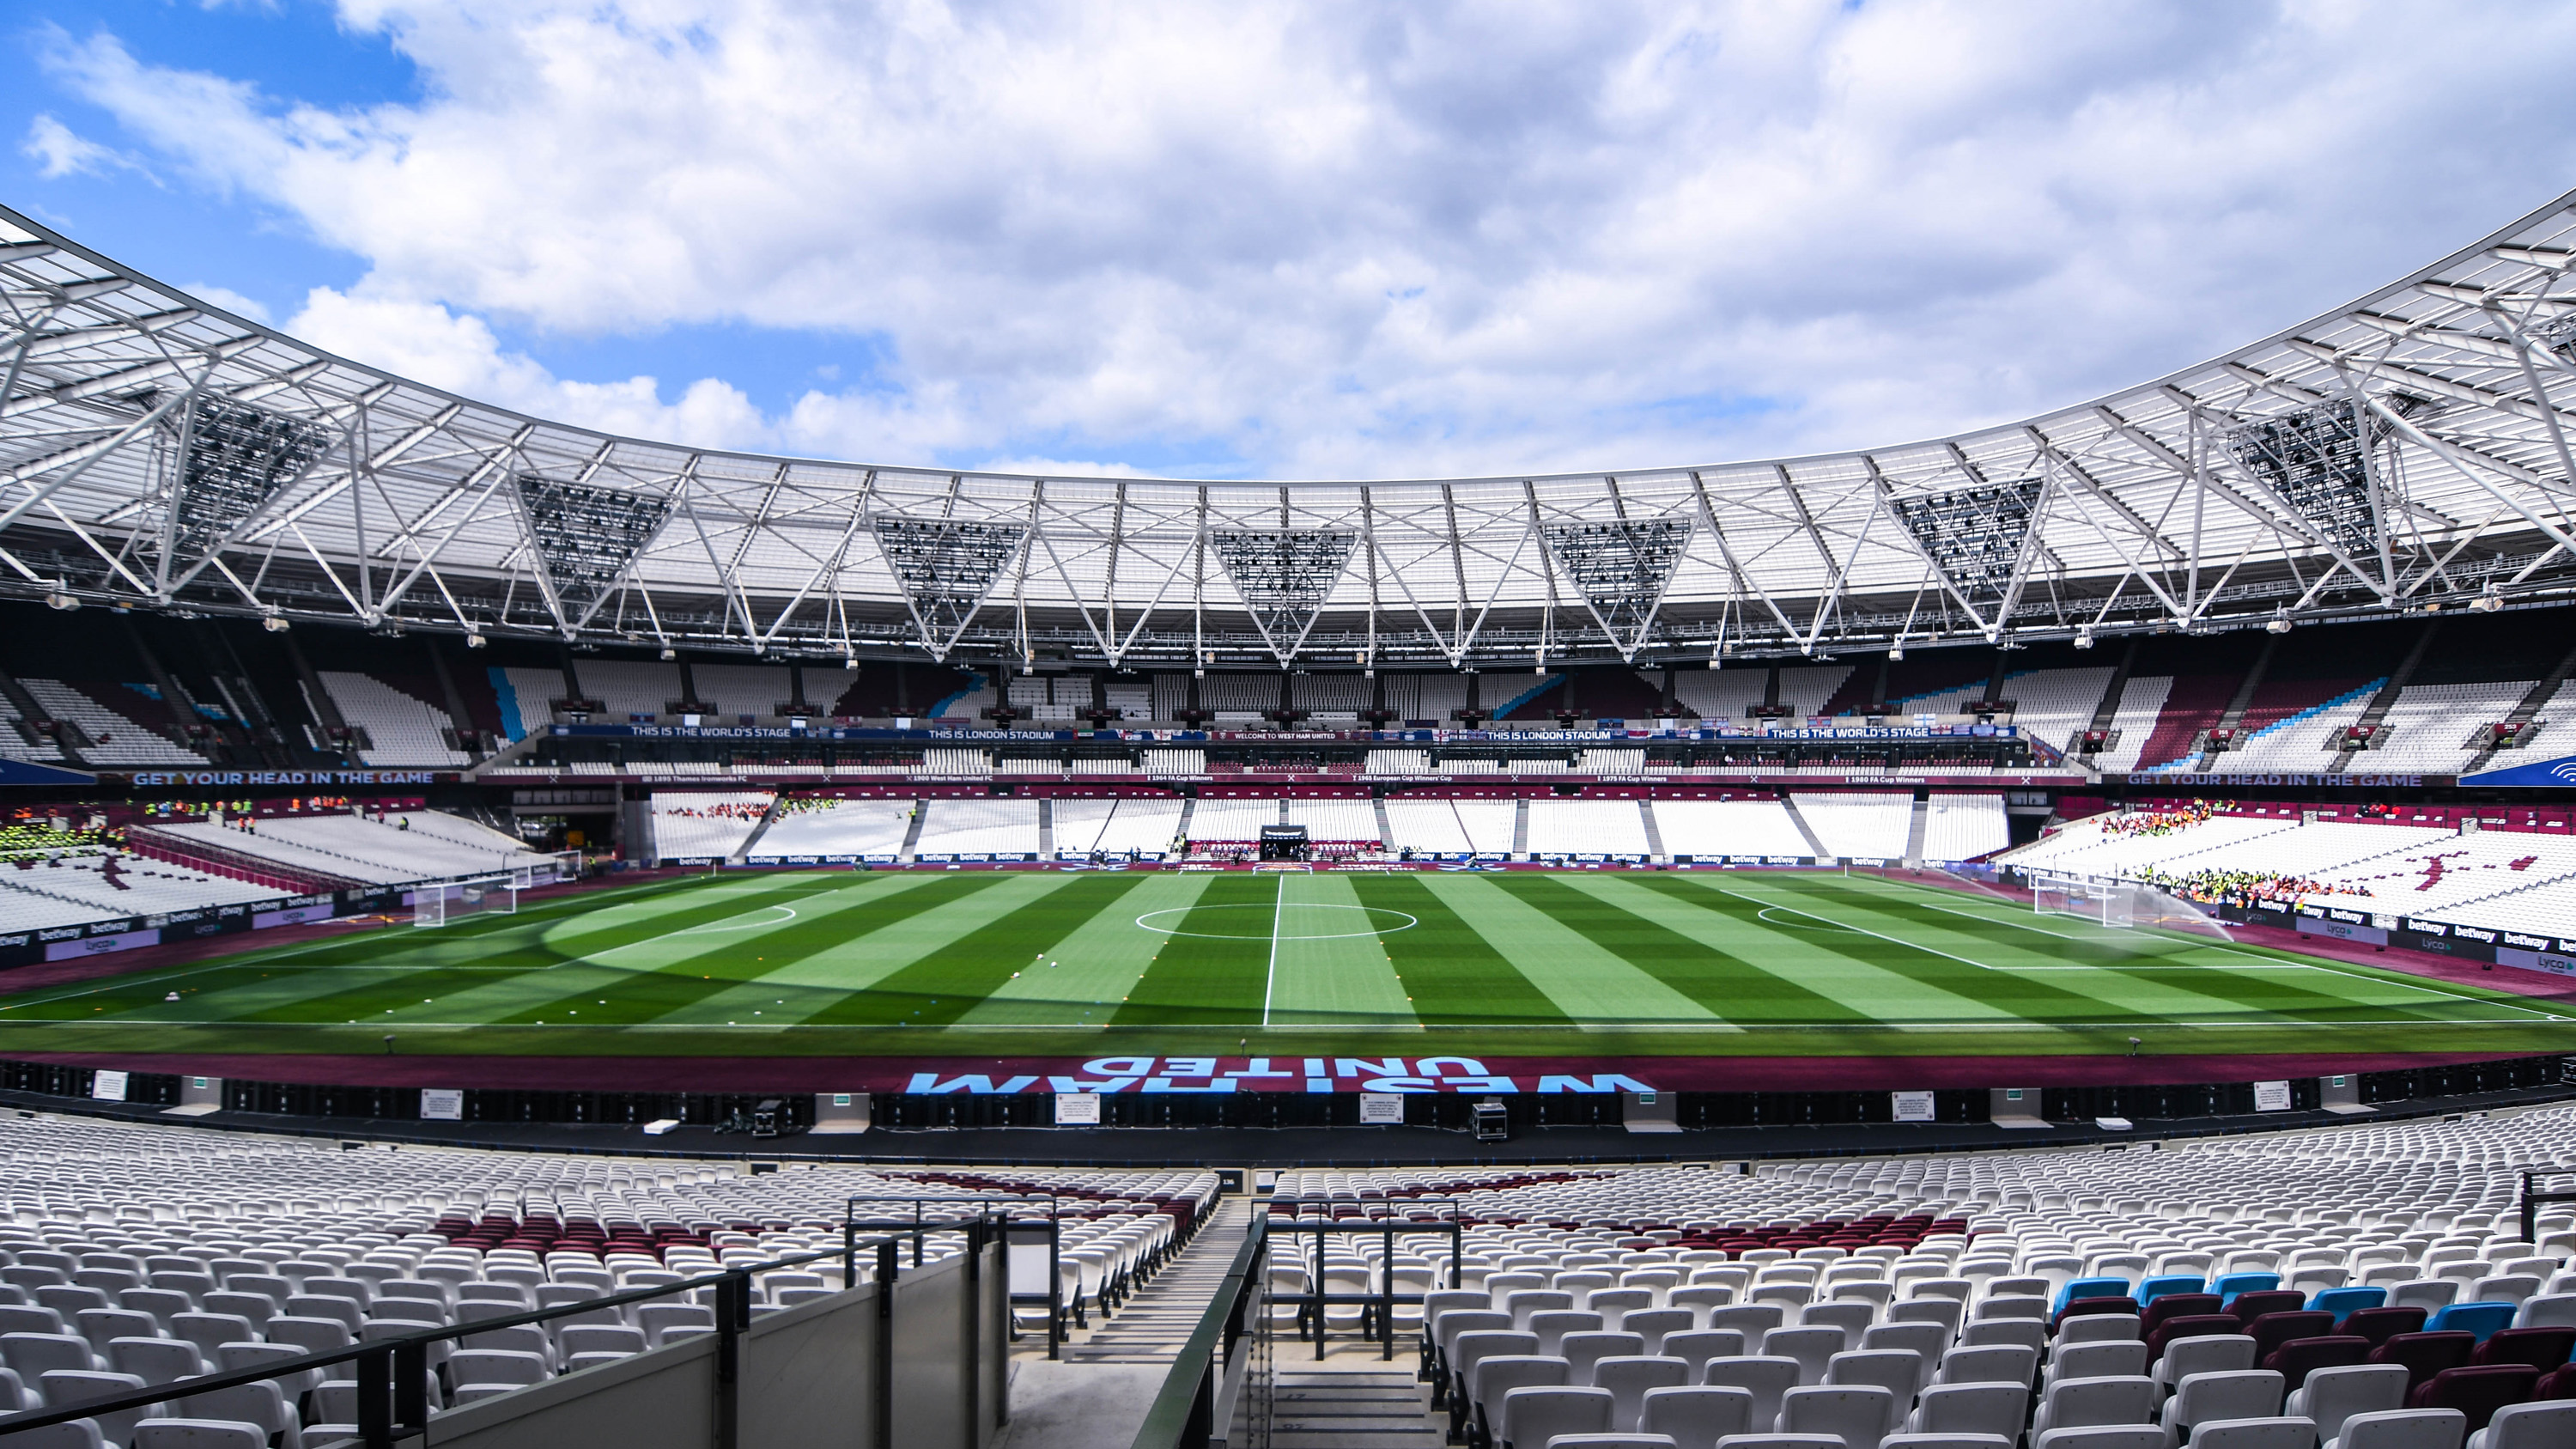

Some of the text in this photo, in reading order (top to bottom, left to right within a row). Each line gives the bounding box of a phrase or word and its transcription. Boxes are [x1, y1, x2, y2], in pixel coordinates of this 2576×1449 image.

[632, 727, 791, 738] THIS IS THE WORLD'S STAGE
[929, 730, 1054, 740] THIS IS LONDON STADIUM
[1487, 731, 1611, 740] THIS IS LONDON STADIUM
[1771, 728, 1929, 739] THIS IS THE WORLD'S STAGE
[132, 772, 434, 785] GET YOUR HEAD IN THE GAME
[2128, 774, 2422, 787] GET YOUR HEAD IN THE GAME
[750, 856, 781, 865] betway
[826, 855, 857, 863] betway
[922, 854, 953, 862] betway
[959, 853, 990, 861] betway
[995, 853, 1025, 861] betway
[1476, 852, 1504, 861] betway
[1576, 854, 1606, 862] betway
[1692, 855, 1722, 864] betway
[1729, 855, 1760, 864] betway
[1767, 855, 1798, 865] betway
[1852, 857, 1885, 868] betway
[251, 901, 282, 912] betway
[288, 895, 316, 907] betway
[2258, 898, 2288, 914] betway
[2330, 908, 2364, 925] betway
[90, 921, 131, 934] betway
[2327, 923, 2346, 935] Lyca
[2408, 918, 2447, 937] betway
[39, 928, 83, 941] betway
[2454, 925, 2496, 944] betway
[86, 940, 110, 951] Lyca
[2422, 938, 2445, 951] Lyca
[2505, 932, 2550, 951] betway
[2538, 956, 2565, 969] Lyca
[1082, 1056, 1490, 1077] UNITED
